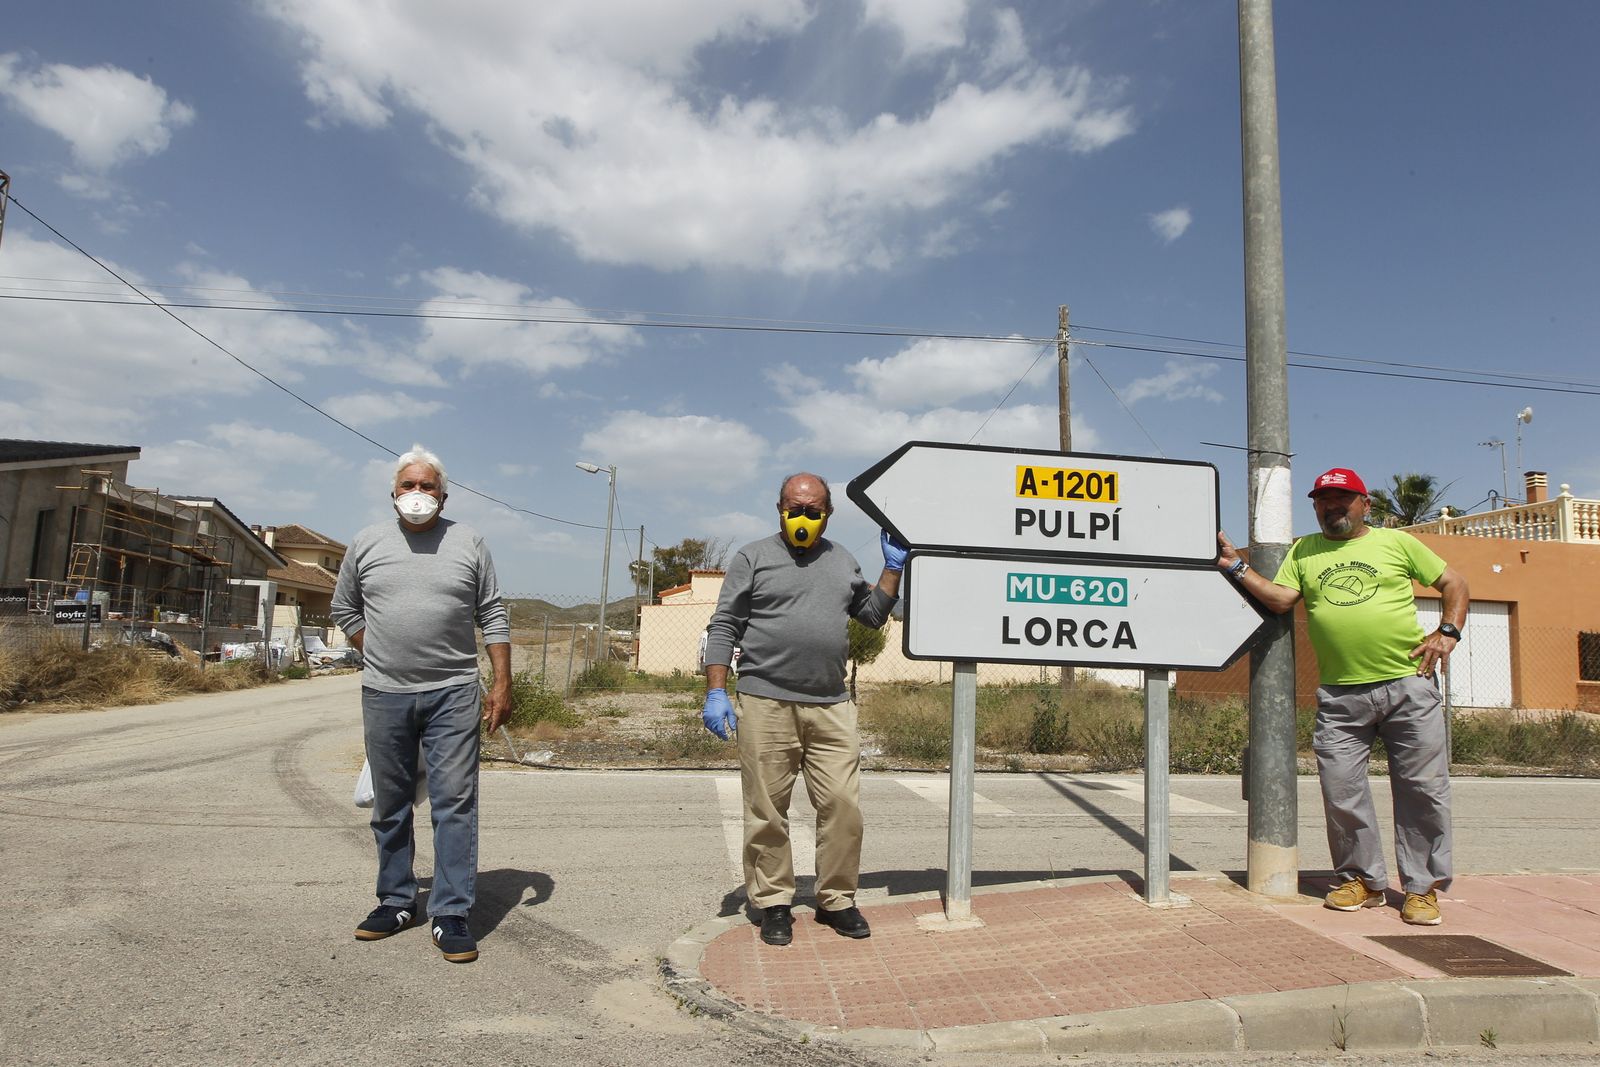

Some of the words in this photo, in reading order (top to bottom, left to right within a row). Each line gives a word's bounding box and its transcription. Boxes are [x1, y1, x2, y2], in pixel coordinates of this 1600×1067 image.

[1019, 467, 1116, 501] A-1201
[1015, 507, 1122, 541] PULPÍ
[1009, 575, 1125, 604] MU-620
[1002, 615, 1138, 650] LORCA
